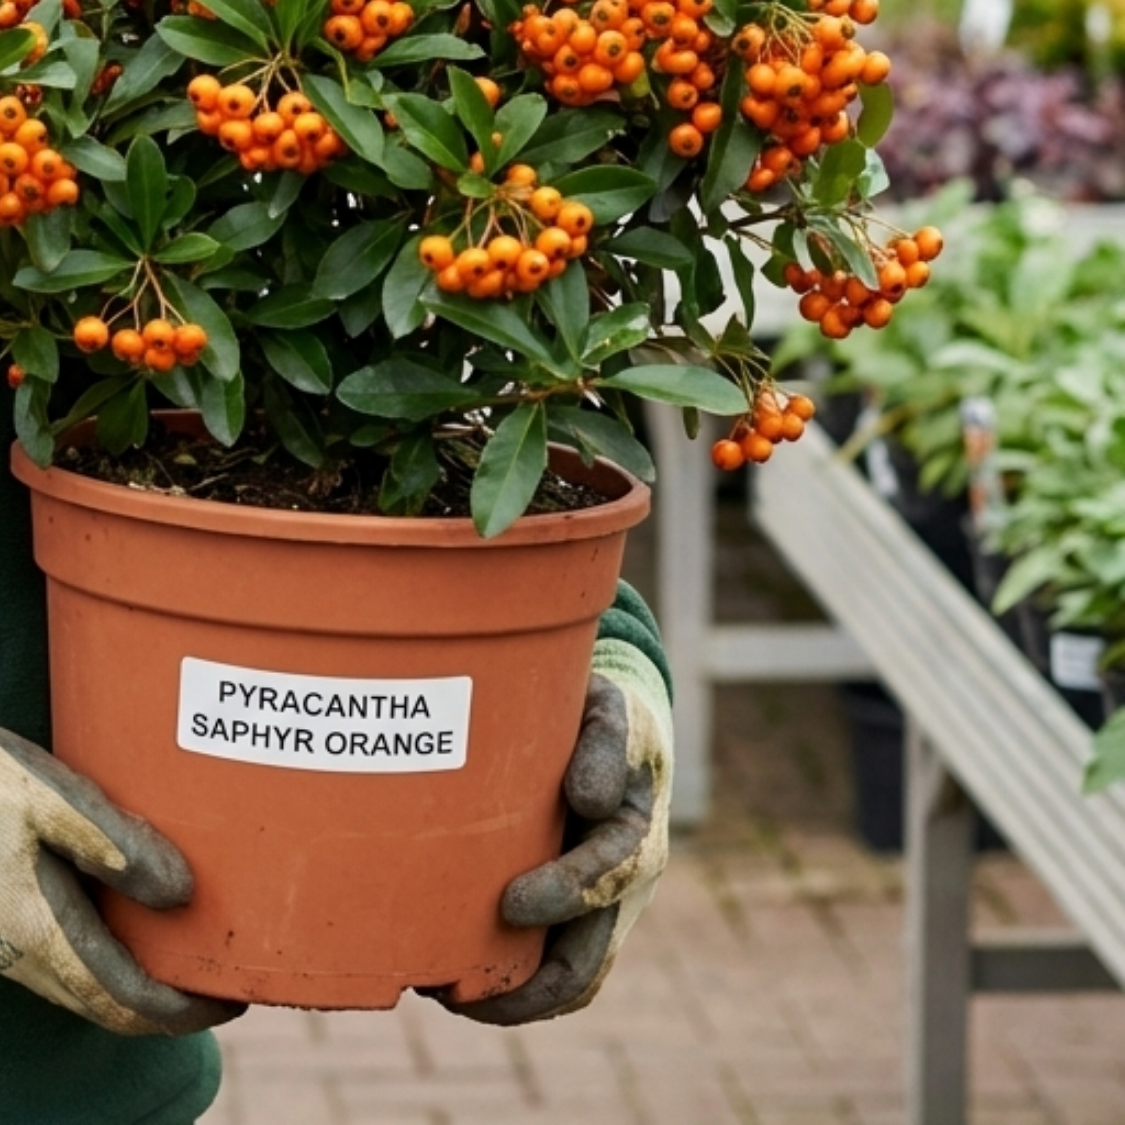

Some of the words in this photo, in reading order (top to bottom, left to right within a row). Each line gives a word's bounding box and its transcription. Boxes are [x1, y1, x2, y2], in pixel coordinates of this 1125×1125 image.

[218, 680, 430, 719] PYRACANTHA
[191, 713, 314, 753] SAPHYR
[324, 731, 454, 756] ORANGE
